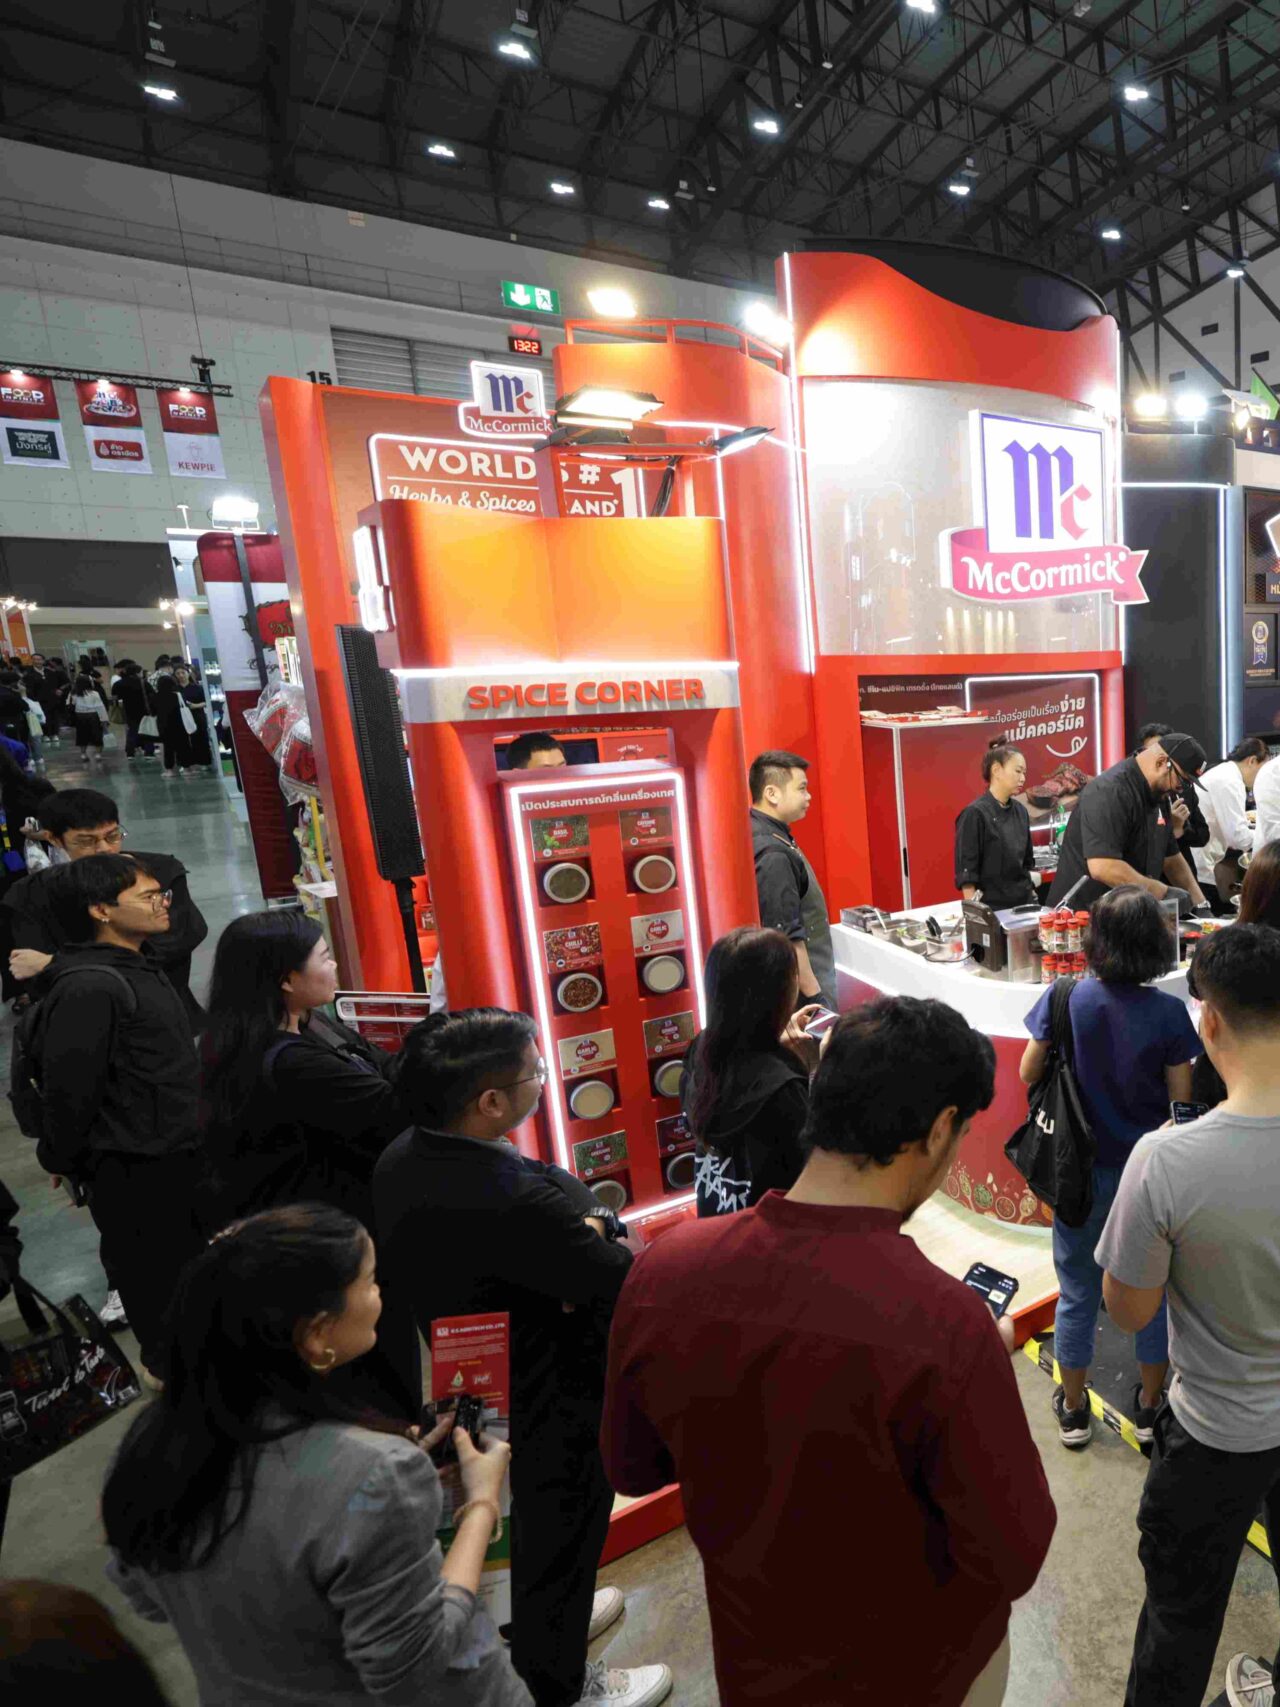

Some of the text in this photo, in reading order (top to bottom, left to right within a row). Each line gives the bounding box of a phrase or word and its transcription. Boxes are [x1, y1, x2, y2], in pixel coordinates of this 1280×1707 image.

[514, 339, 539, 354] 1322
[466, 415, 552, 433] McCormick
[177, 461, 215, 472] KEWPIE
[458, 491, 472, 508] &
[479, 491, 536, 513] Spices
[961, 552, 1125, 594] McCormick
[467, 678, 704, 709] SPICE CORNER
